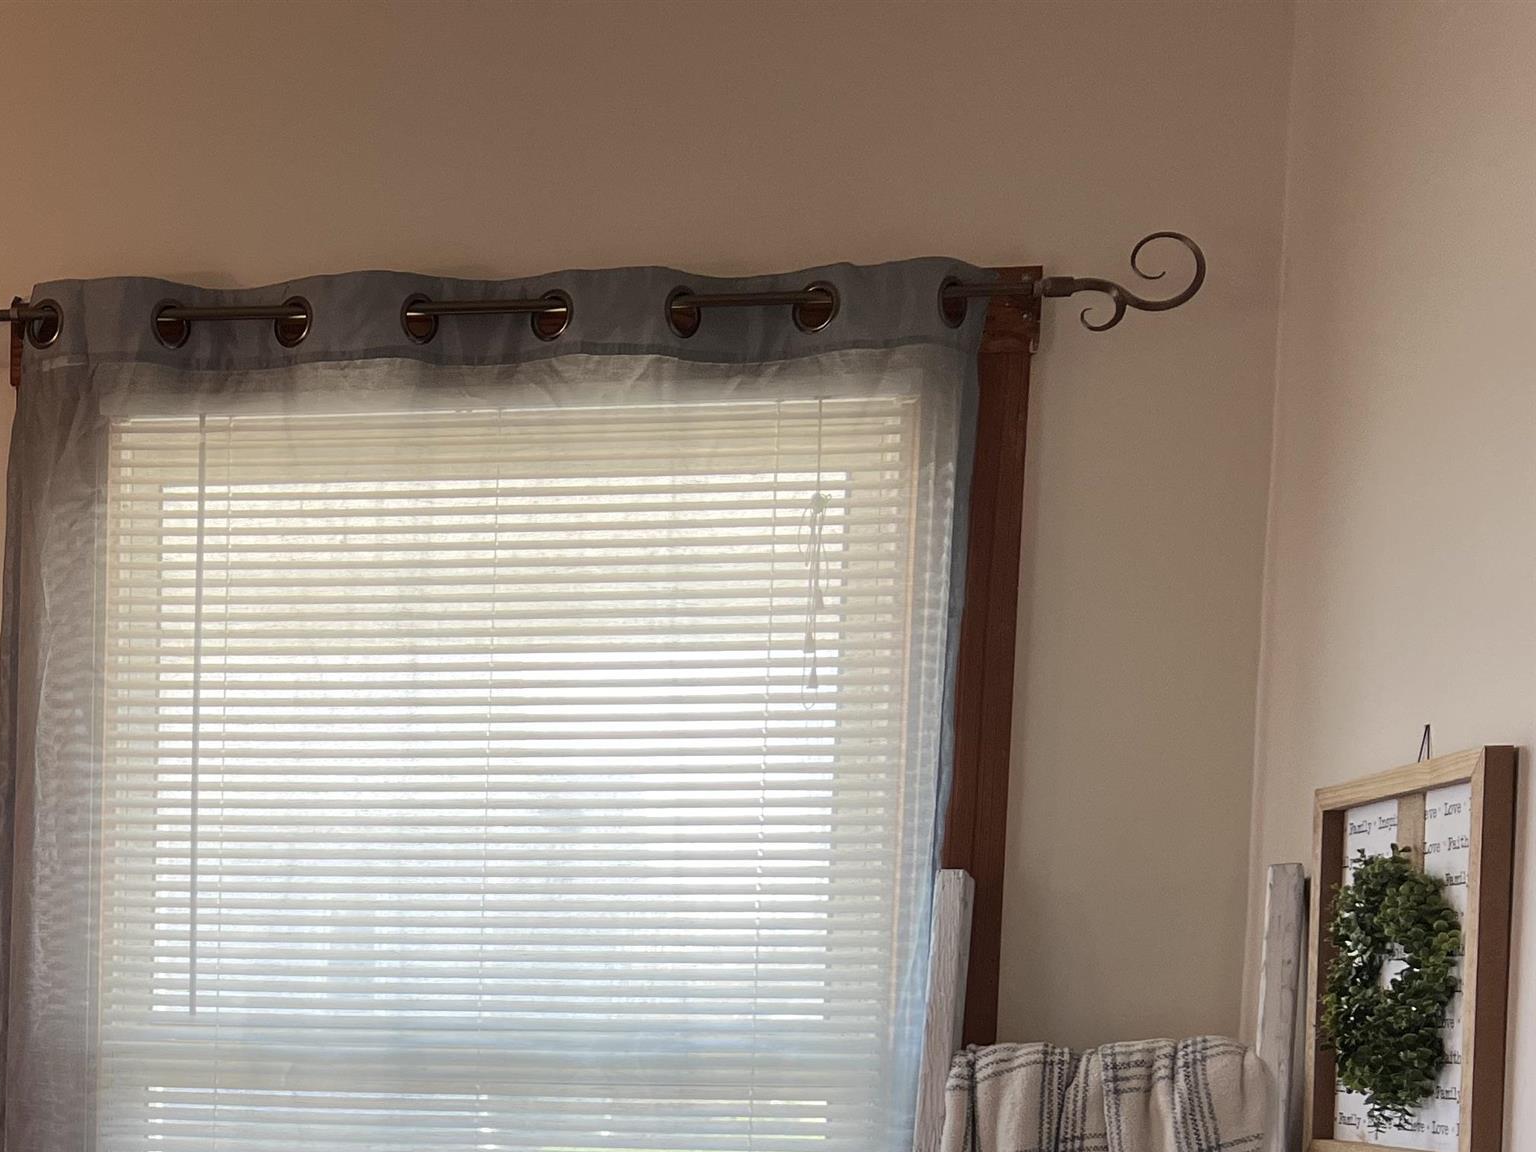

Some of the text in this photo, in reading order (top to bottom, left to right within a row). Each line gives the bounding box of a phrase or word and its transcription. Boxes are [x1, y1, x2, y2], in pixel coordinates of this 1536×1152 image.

[1349, 820, 1372, 836] Family
[1444, 802, 1462, 816] Love
[1447, 834, 1470, 852] Faith
[1339, 1112, 1362, 1130] Family
[1432, 1120, 1449, 1136] Love
